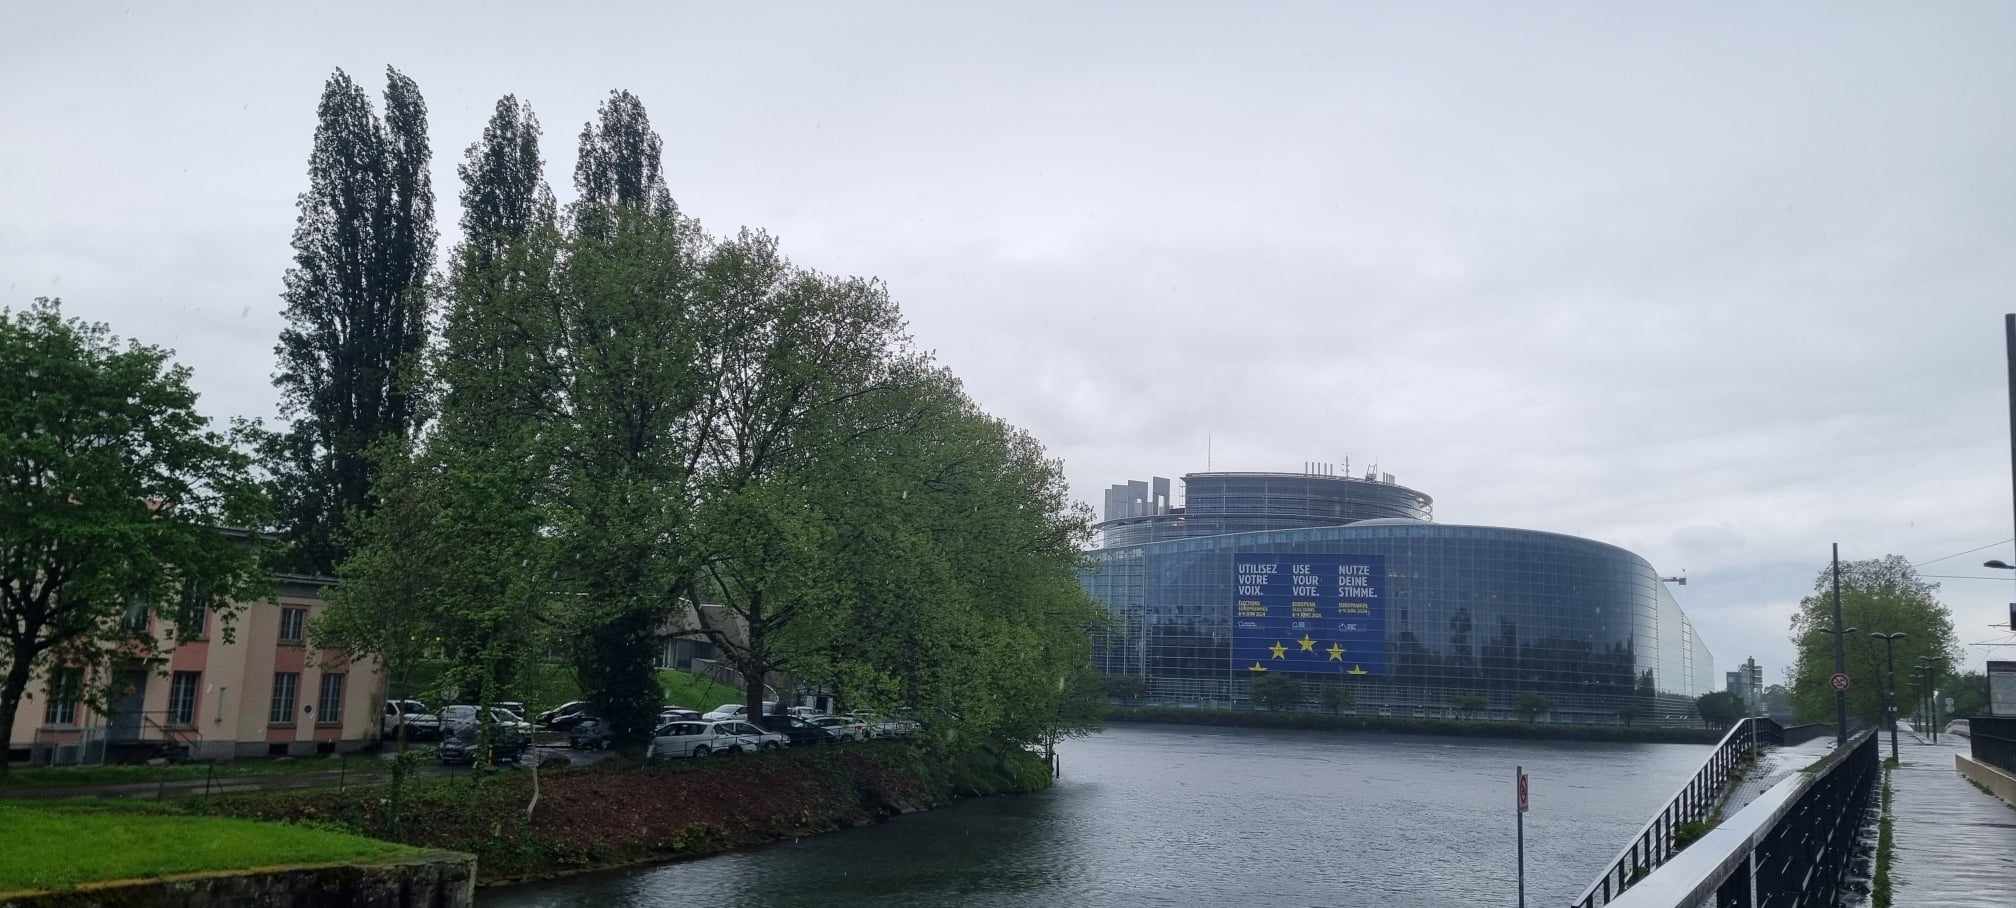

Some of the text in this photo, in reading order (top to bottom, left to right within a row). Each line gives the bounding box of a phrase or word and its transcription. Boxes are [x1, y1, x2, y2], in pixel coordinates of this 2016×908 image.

[1238, 563, 1278, 574] UTILISEZ
[1292, 564, 1311, 574] USE
[1338, 565, 1370, 575] NUTZE
[1238, 574, 1268, 585] VOTRE
[1292, 575, 1319, 585] YOUR
[1338, 576, 1368, 586] DEINE
[1238, 585, 1264, 596] VOIX.
[1292, 586, 1321, 596] VOTE.
[1338, 587, 1378, 597] STIMME.
